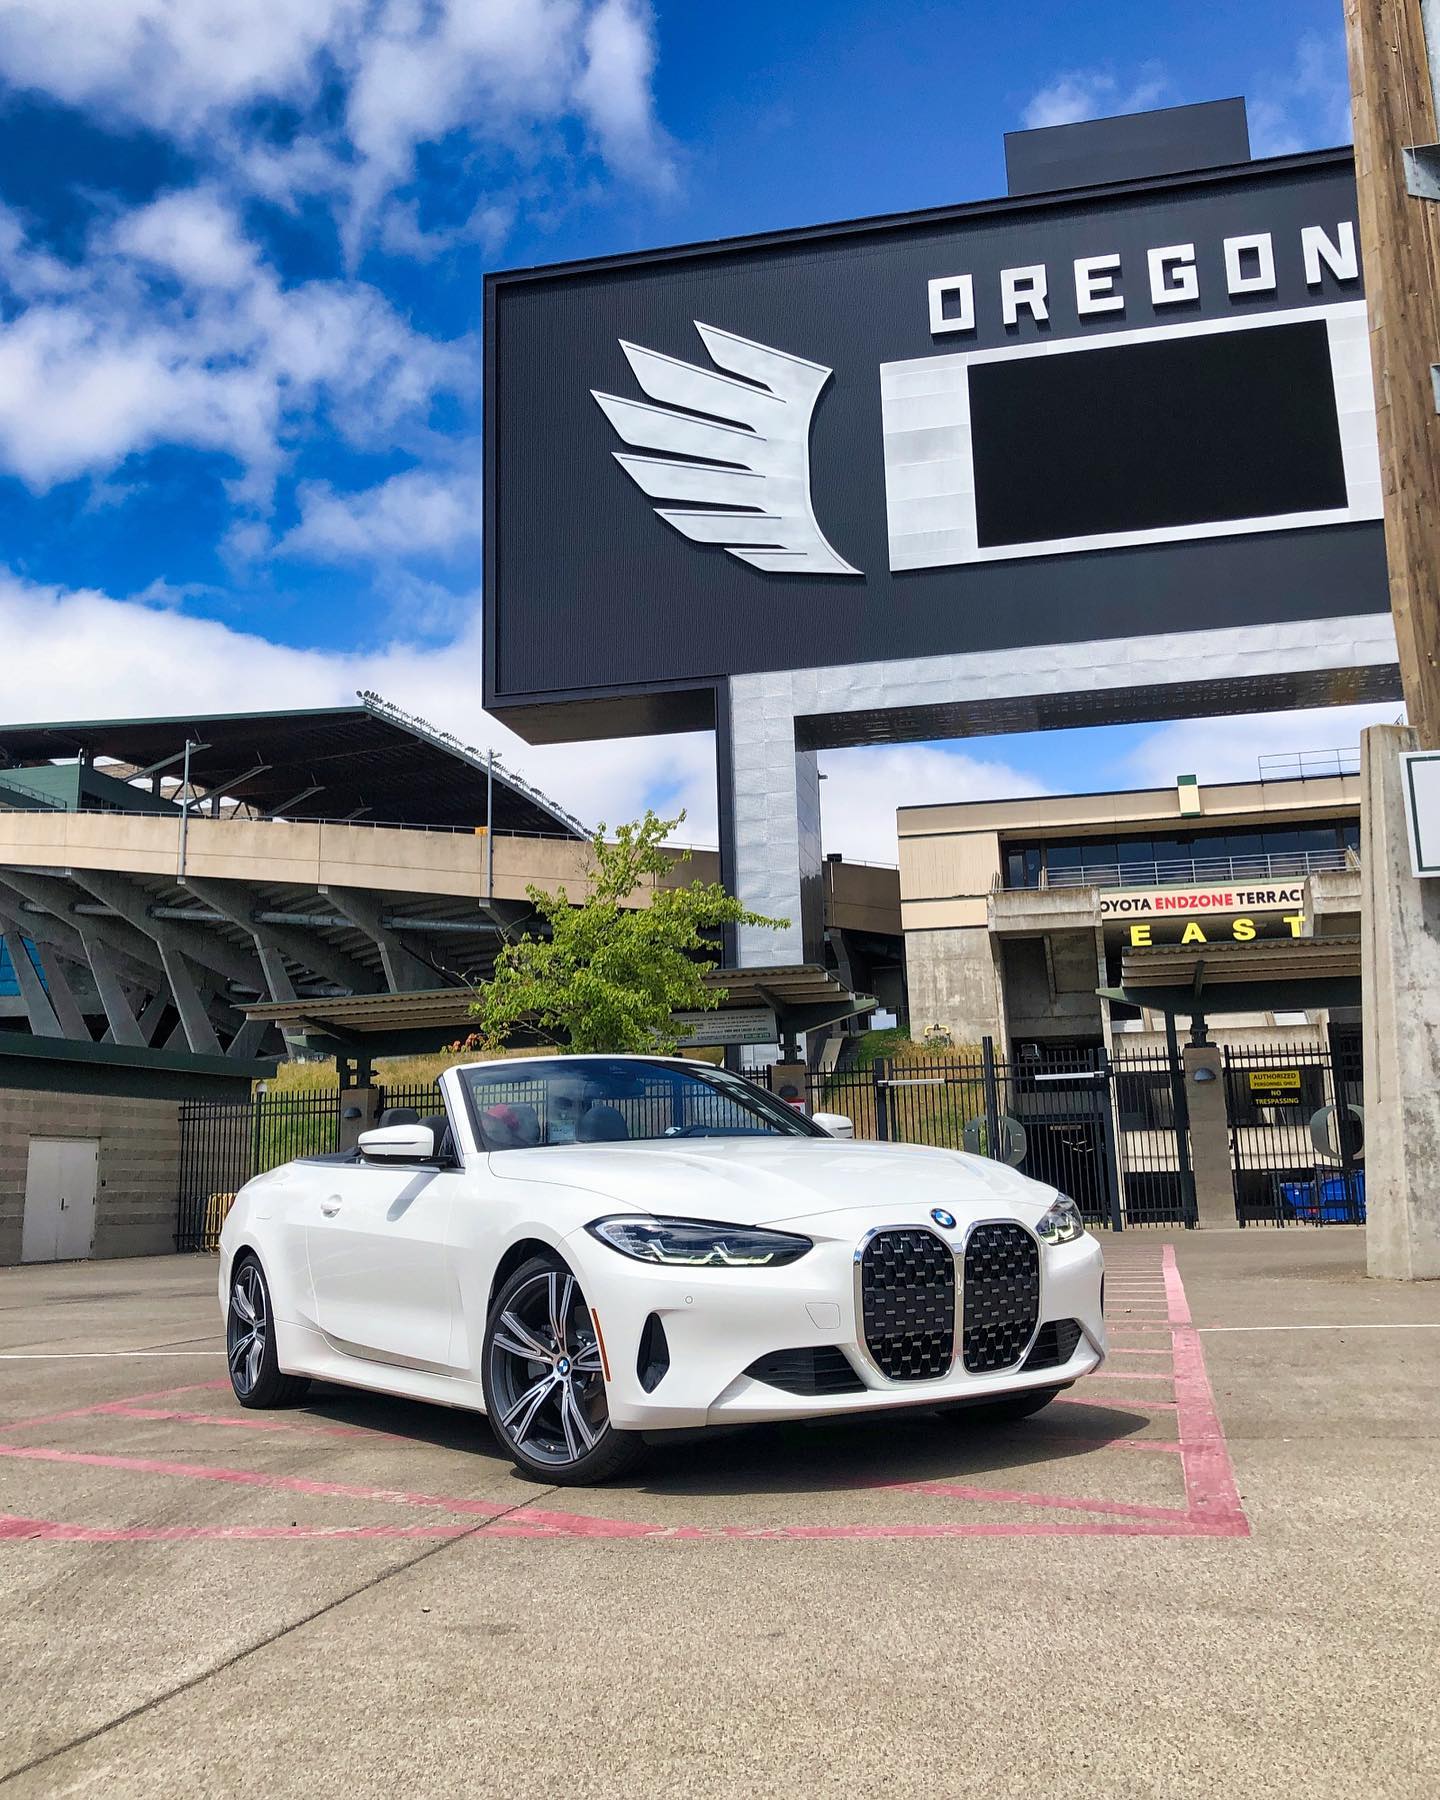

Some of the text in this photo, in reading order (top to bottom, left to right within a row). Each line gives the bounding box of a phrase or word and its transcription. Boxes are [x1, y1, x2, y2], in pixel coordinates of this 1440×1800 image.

[928, 221, 1359, 334] OREGON
[1100, 898, 1152, 913] OYOTA
[1155, 893, 1233, 910] ENDZONE
[1130, 916, 1306, 947] EAST
